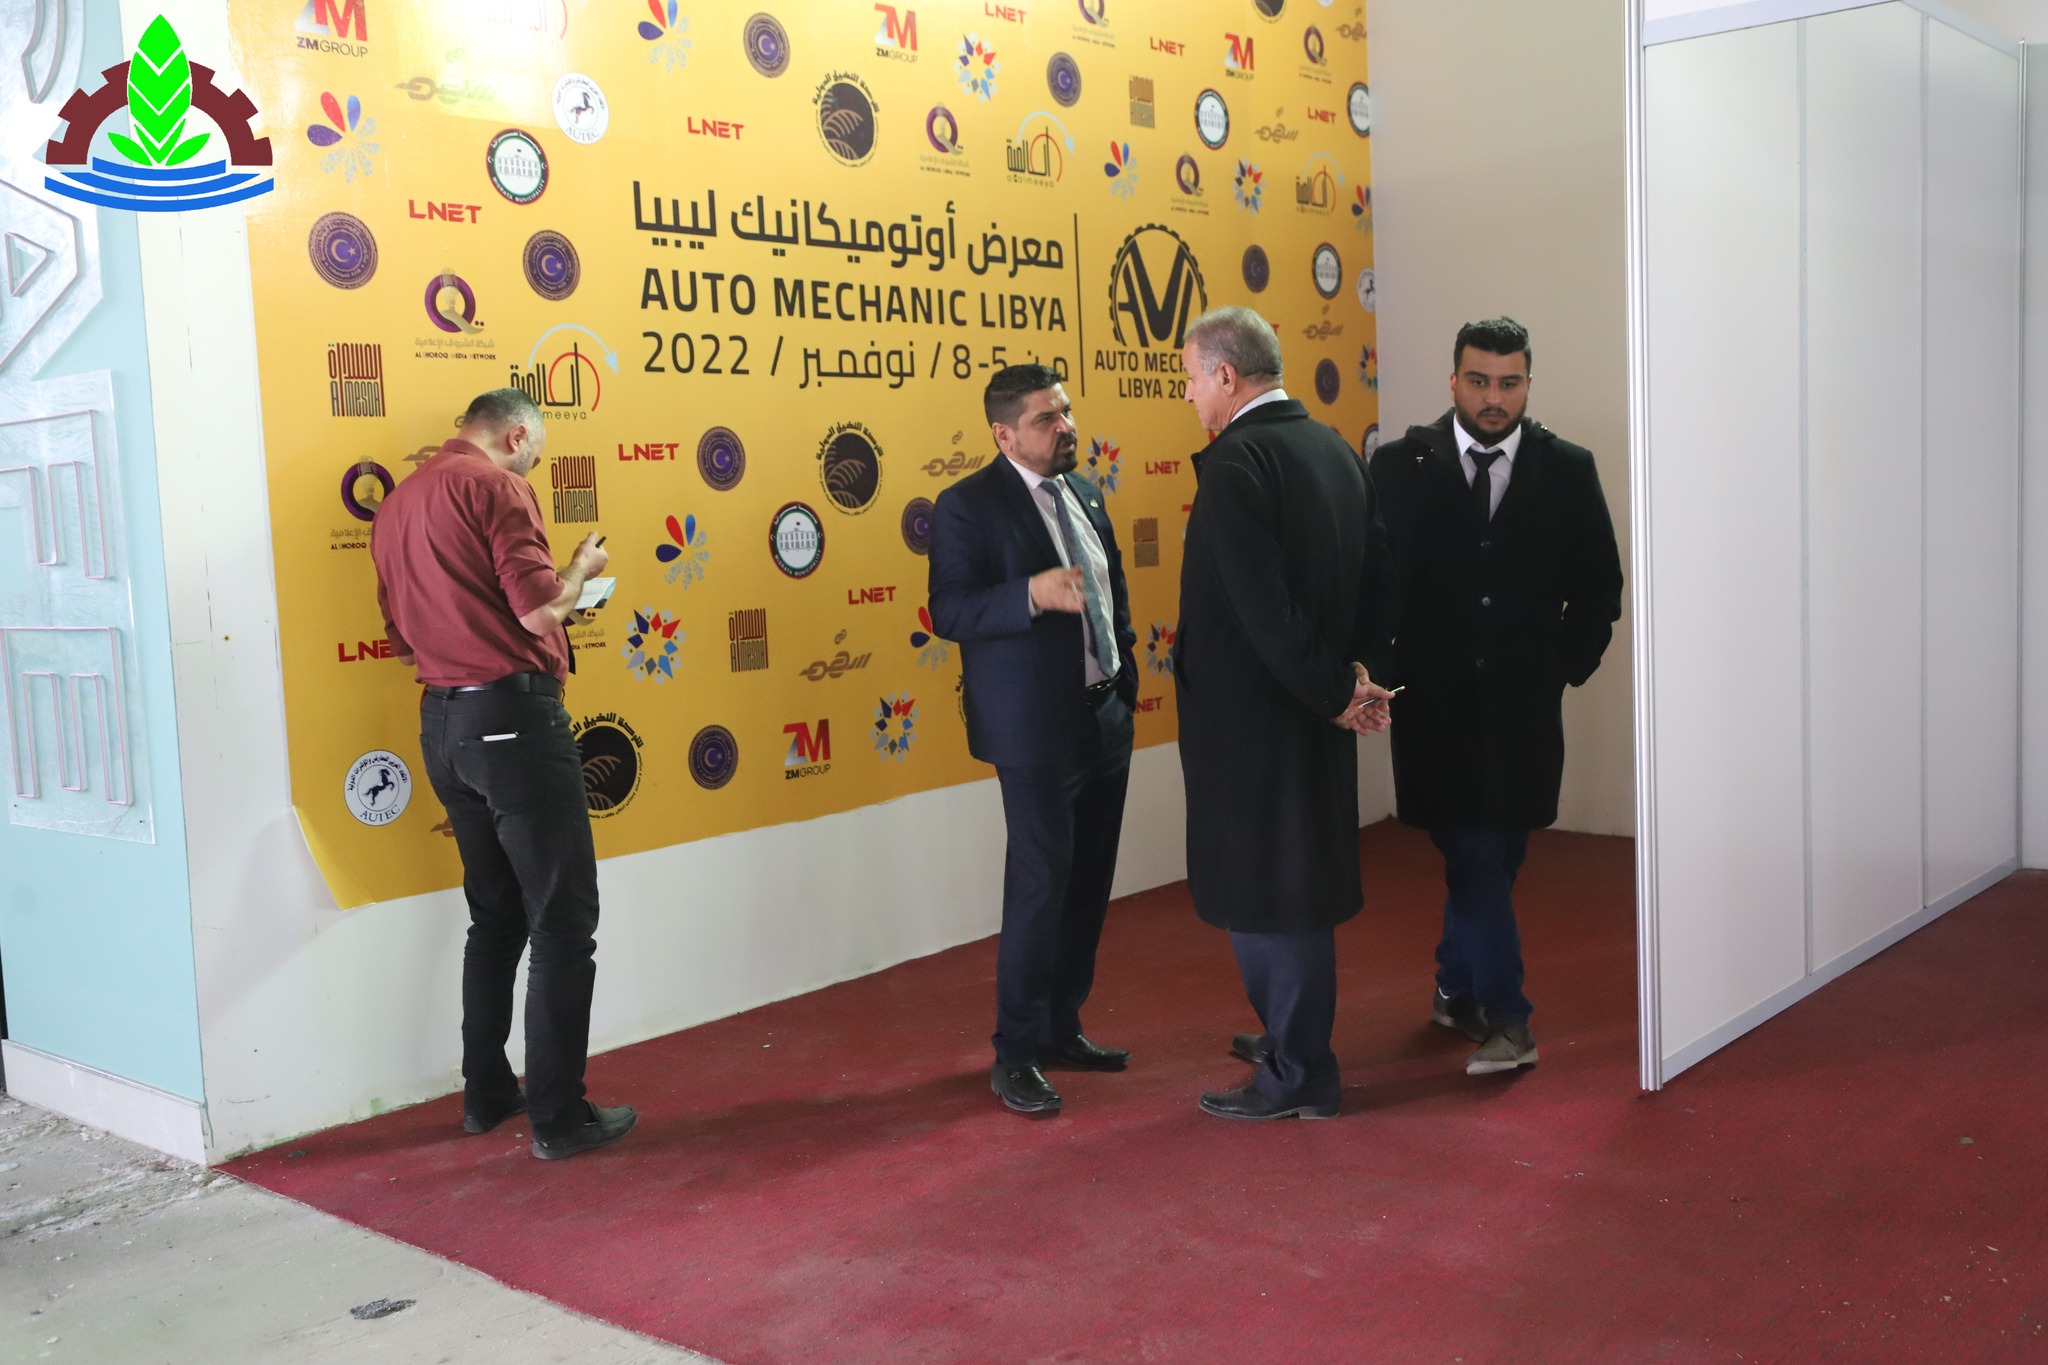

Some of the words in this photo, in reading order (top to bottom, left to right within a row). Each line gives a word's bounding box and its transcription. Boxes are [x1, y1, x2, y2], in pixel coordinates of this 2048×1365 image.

[985, 2, 1027, 25] LNET
[1149, 36, 1186, 57] LNET
[1307, 107, 1337, 124] LNET
[687, 116, 745, 140] LNET
[408, 199, 482, 225] LNET
[632, 180, 717, 250] ليبيا
[730, 194, 956, 272] أوتوميكانيك
[967, 222, 1065, 278] معرض
[640, 267, 756, 316] AUTO
[774, 277, 967, 327] MECHANIC
[981, 292, 1067, 332] LIBYA
[643, 330, 750, 376] 2022
[799, 340, 916, 389] نوفمبر
[1095, 349, 1139, 371] AUTO
[1118, 377, 1163, 399] LIBYA
[543, 410, 587, 421] meeya
[618, 443, 680, 461] LNET
[1145, 461, 1181, 475] LNET
[848, 586, 896, 604] LNET
[338, 639, 396, 662] LNE
[1134, 696, 1163, 714] NET
